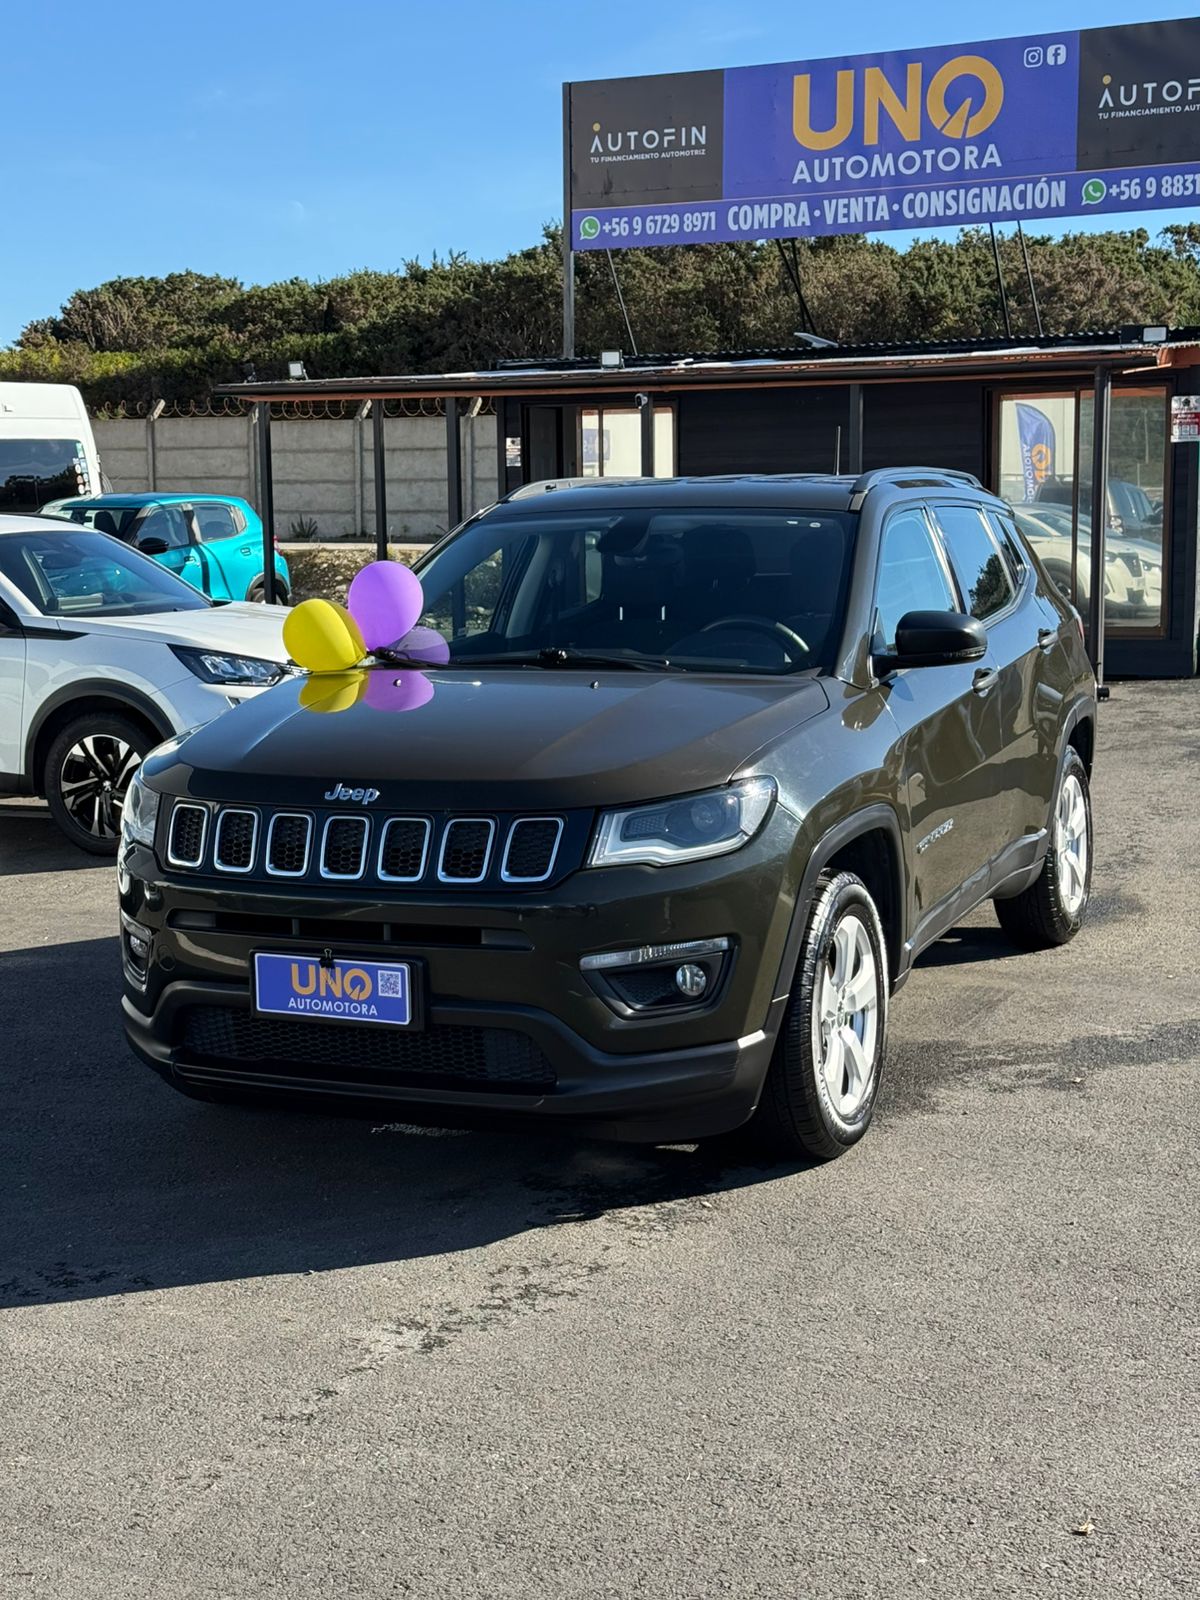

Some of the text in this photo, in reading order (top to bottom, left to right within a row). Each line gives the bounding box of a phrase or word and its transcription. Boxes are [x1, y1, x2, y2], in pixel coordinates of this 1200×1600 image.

[793, 55, 1004, 150] UNO
[1098, 75, 1200, 108] AUTOF
[1111, 106, 1182, 118] FINANCIAMIENTO
[590, 123, 706, 153] AUTOFIN
[601, 153, 660, 162] FINANCIAMIENTO
[661, 149, 706, 158] AUTOMOTRIZ
[792, 143, 1002, 184] AUTOMOTORA
[1109, 173, 1200, 200] +56 9 8831
[727, 177, 1067, 231] COMPRA VENTA CONSIGNACIÓN
[602, 211, 716, 237] +56 9 6729 8971
[324, 783, 380, 805] Jeep
[291, 963, 373, 1001] UNO
[288, 997, 378, 1016] AUTOMOTORA
